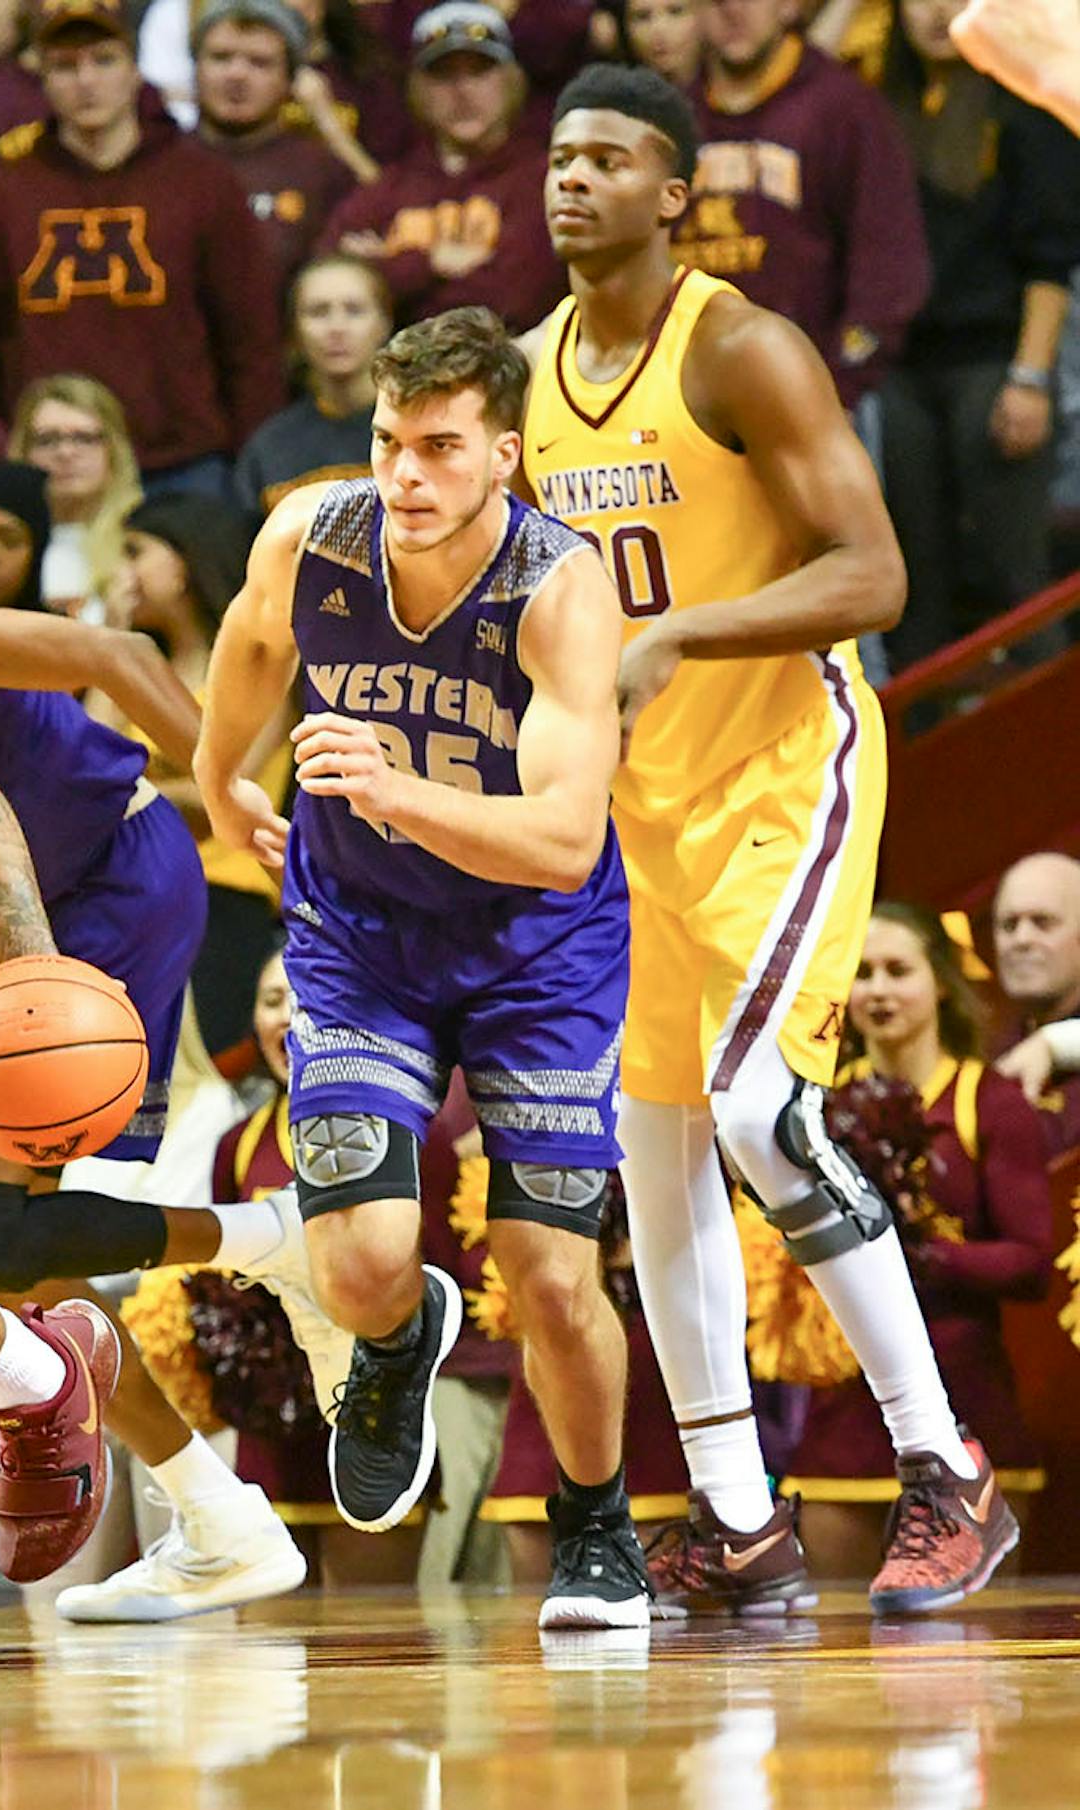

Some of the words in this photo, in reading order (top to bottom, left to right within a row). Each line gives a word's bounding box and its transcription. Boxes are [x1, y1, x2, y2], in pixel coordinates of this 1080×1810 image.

[18, 206, 166, 313] M
[537, 462, 680, 516] MINNESOTA
[306, 662, 517, 750] WESTERN
